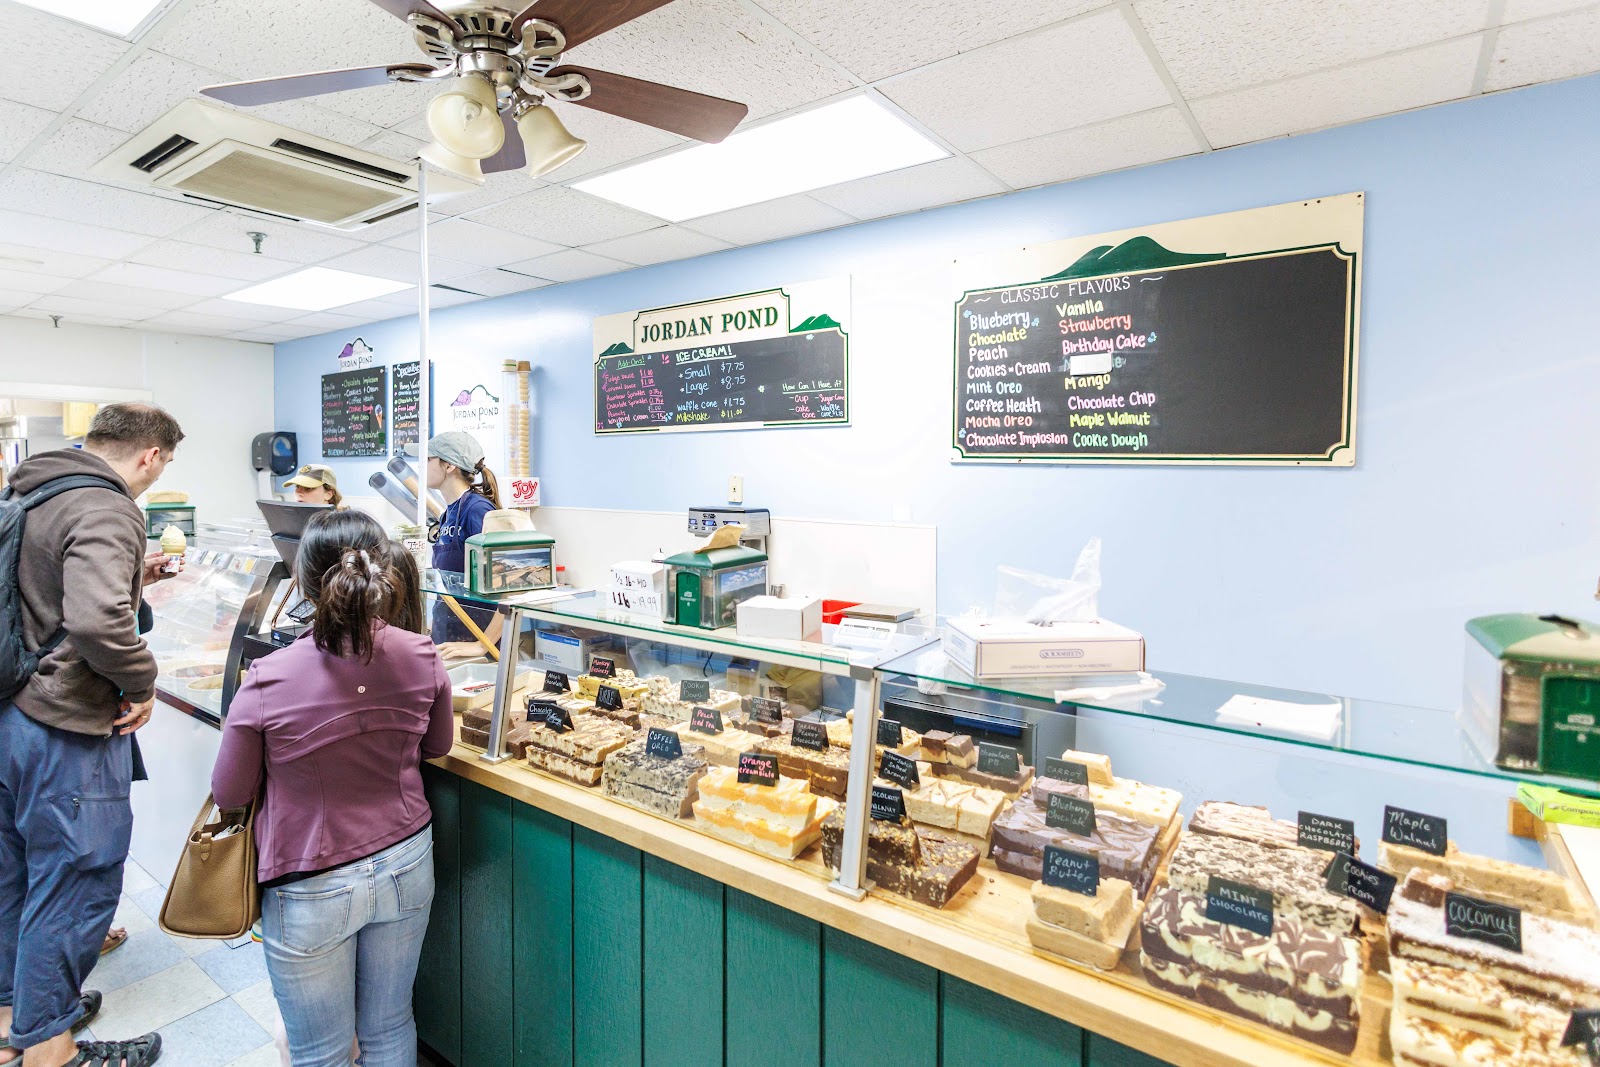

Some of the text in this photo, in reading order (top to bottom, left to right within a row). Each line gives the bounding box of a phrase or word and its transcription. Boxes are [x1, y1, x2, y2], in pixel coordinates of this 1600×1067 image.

[1001, 276, 1130, 304] CLASSIC FLAVORS
[1056, 299, 1104, 317] Vanilla
[641, 306, 779, 343] JORDAN POND
[970, 312, 1030, 330] Blueberry
[1059, 314, 1131, 335] Strawberry
[969, 327, 1027, 347] Chocolate
[1062, 334, 1146, 355] Birthday Cake
[676, 345, 732, 362] ICE CREAM!
[969, 346, 1008, 362] Peach
[684, 362, 744, 380] Small $7.75
[967, 365, 1007, 379] Cookies
[1015, 362, 1051, 376] Cream
[686, 375, 746, 395] Large $8.75
[782, 383, 795, 391] How
[967, 382, 1022, 394] Mint Oreo
[1065, 373, 1111, 390] Mango
[701, 400, 718, 409] cone
[724, 397, 745, 407] $1.75
[966, 397, 1041, 413] Coffee Heath
[1068, 391, 1155, 410] Chocolate Chip
[479, 407, 498, 421] POND
[966, 416, 1033, 428] Mocha Oreo
[1070, 412, 1150, 428] Maple Walnut
[966, 431, 1068, 448] Chocolate Implosion
[1073, 432, 1148, 450] Cookie Dough
[697, 710, 714, 719] Peach
[692, 718, 715, 729] Iced Tea
[797, 724, 821, 732] CARAMEL
[649, 731, 673, 744] COFFEE
[793, 737, 821, 746] CHOCOLATE
[798, 730, 818, 738] PEANUT
[652, 742, 668, 751] OREO
[742, 756, 772, 770] Orange
[1047, 765, 1081, 778] CARROT
[872, 790, 900, 802] OCOLATE
[1051, 796, 1089, 818] Blueberry
[1048, 810, 1085, 827] Chocolate
[1311, 818, 1342, 830] DARK
[1388, 811, 1431, 831] Maple
[1299, 825, 1352, 840] CHOCOLATE
[1300, 832, 1353, 849] RASPBERRY
[1390, 826, 1437, 849] Walnut
[1049, 852, 1089, 870] Peanut
[1049, 865, 1092, 882] Butter
[1343, 862, 1378, 886] Cookies
[1220, 887, 1258, 907] MINT
[1341, 881, 1375, 903] Cream
[1210, 897, 1269, 923] CHOCOLATE
